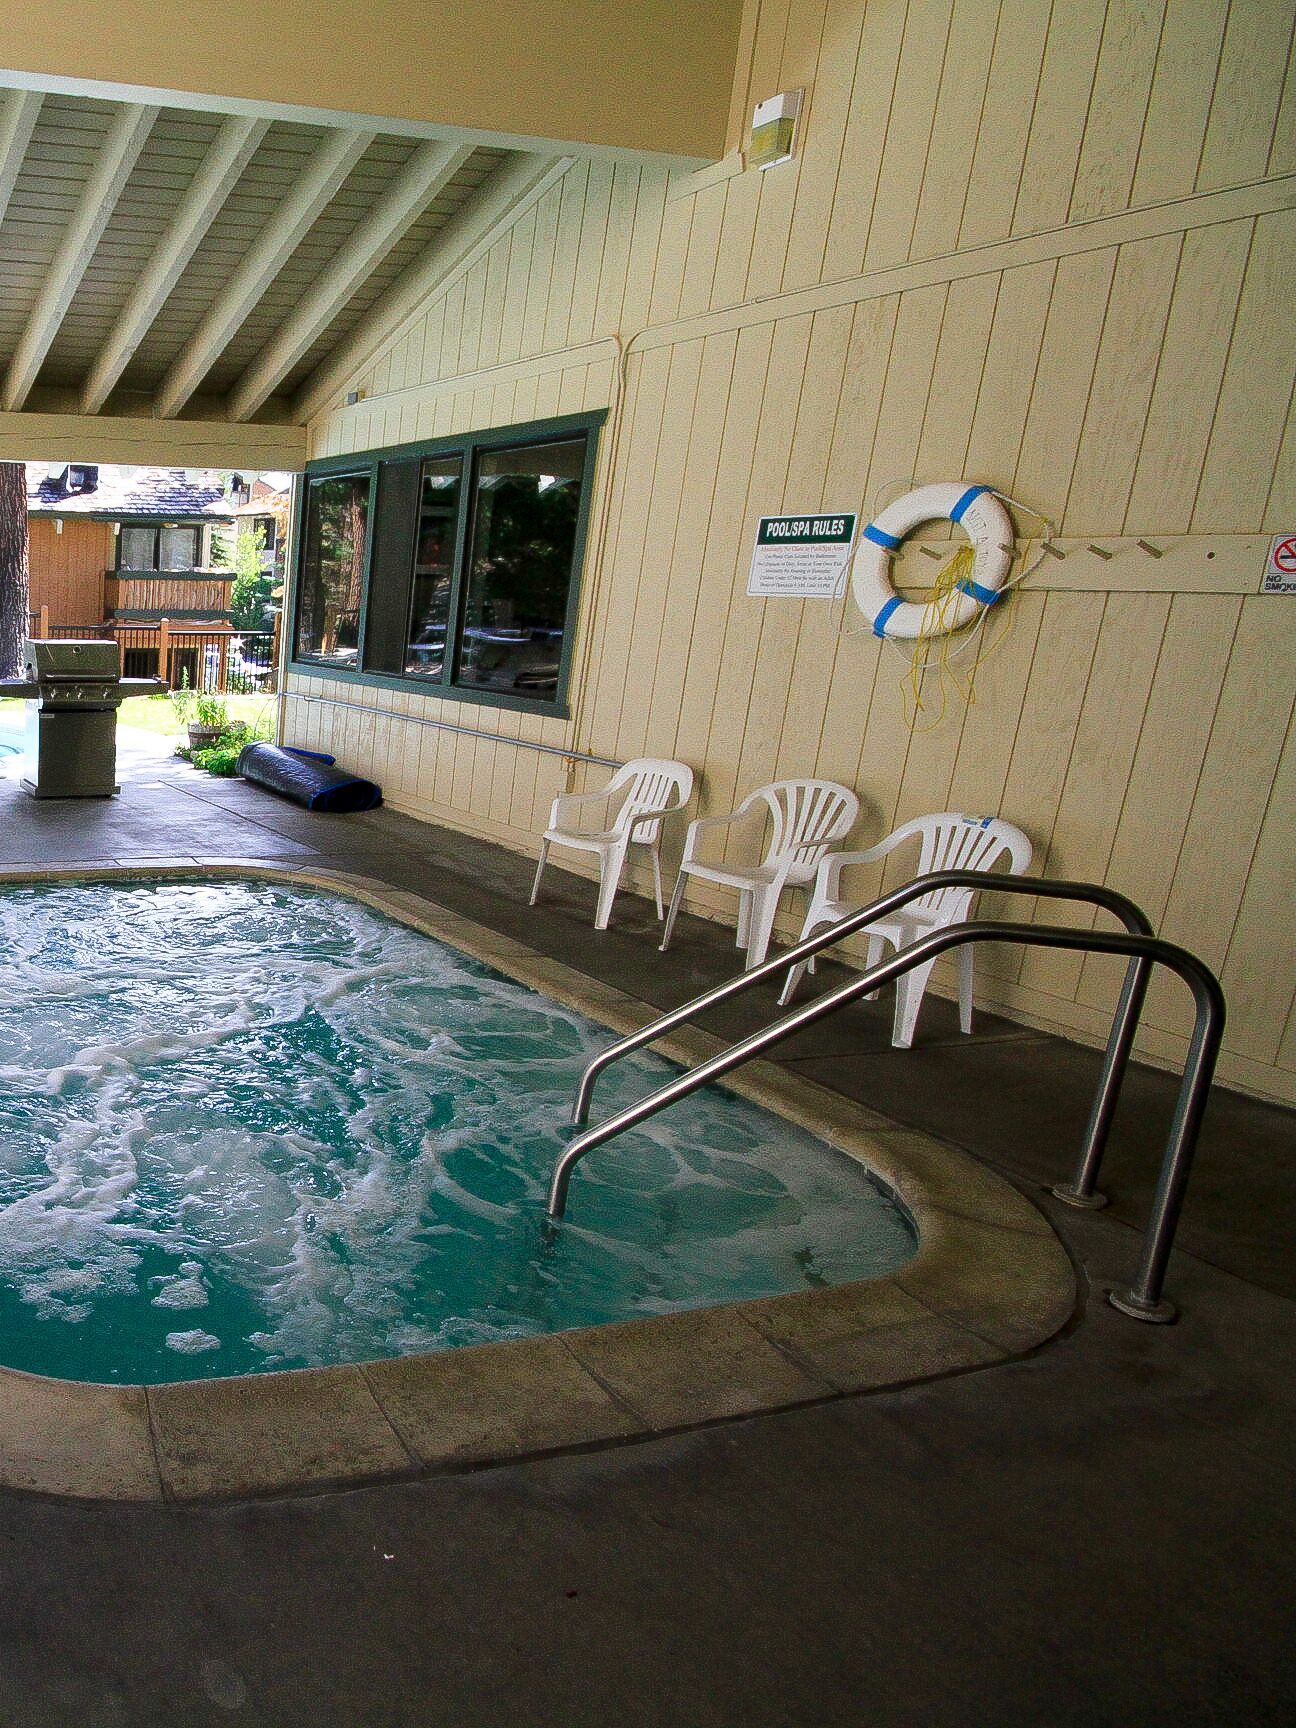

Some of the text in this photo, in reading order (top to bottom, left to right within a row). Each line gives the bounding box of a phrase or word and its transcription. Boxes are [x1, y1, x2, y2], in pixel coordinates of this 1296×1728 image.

[766, 519, 845, 538] POOL/SPA RULES
[1265, 574, 1281, 582] NO
